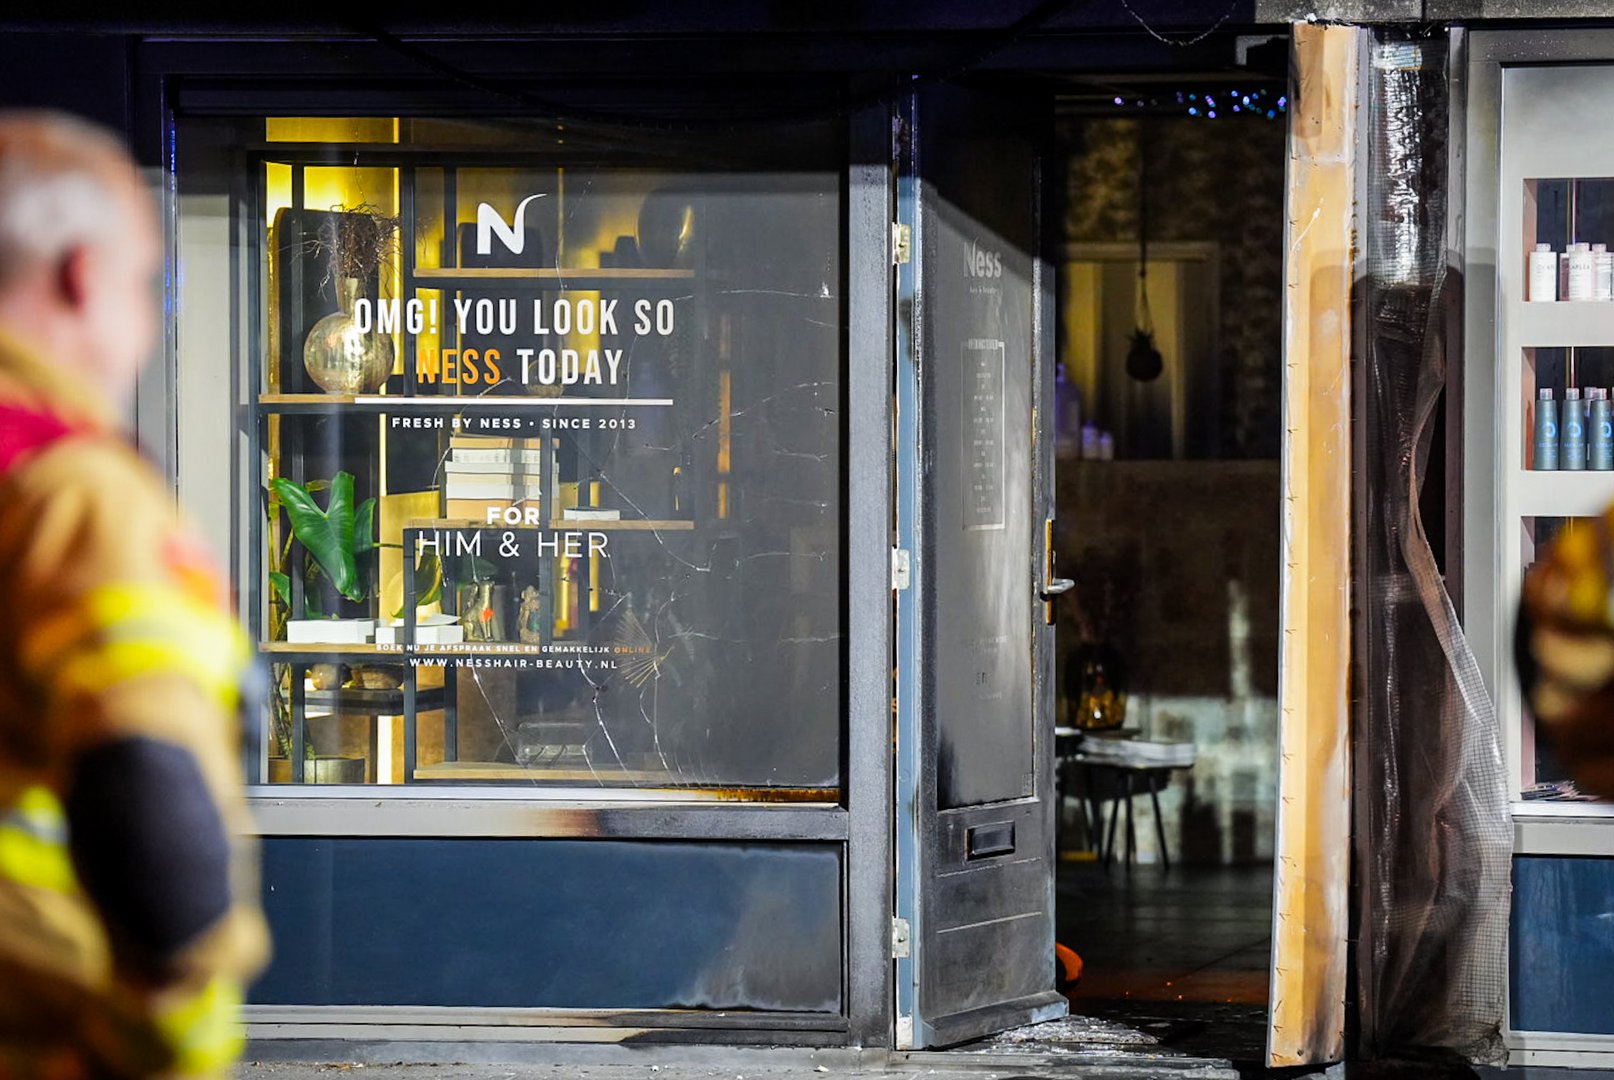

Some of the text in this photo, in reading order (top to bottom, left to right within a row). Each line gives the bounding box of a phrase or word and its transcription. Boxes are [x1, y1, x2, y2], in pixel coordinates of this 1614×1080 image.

[963, 236, 1002, 278] Ness
[354, 298, 675, 336] OMG! YOU LOOK SO
[416, 348, 623, 385] NESS TODAY
[392, 417, 637, 430] FRESH BY NESS SINCE 2013
[487, 507, 540, 525] FOR
[417, 530, 609, 558] HIM & HER
[375, 644, 403, 652] BOEK
[406, 644, 421, 652] NU
[495, 645, 520, 653] SNEL
[524, 645, 538, 653] EN
[541, 646, 610, 654] GEMAKKELIJK
[613, 646, 652, 654] ONLINE
[409, 658, 618, 669] WWW.NESSHAIR-BEAUTY.NL
